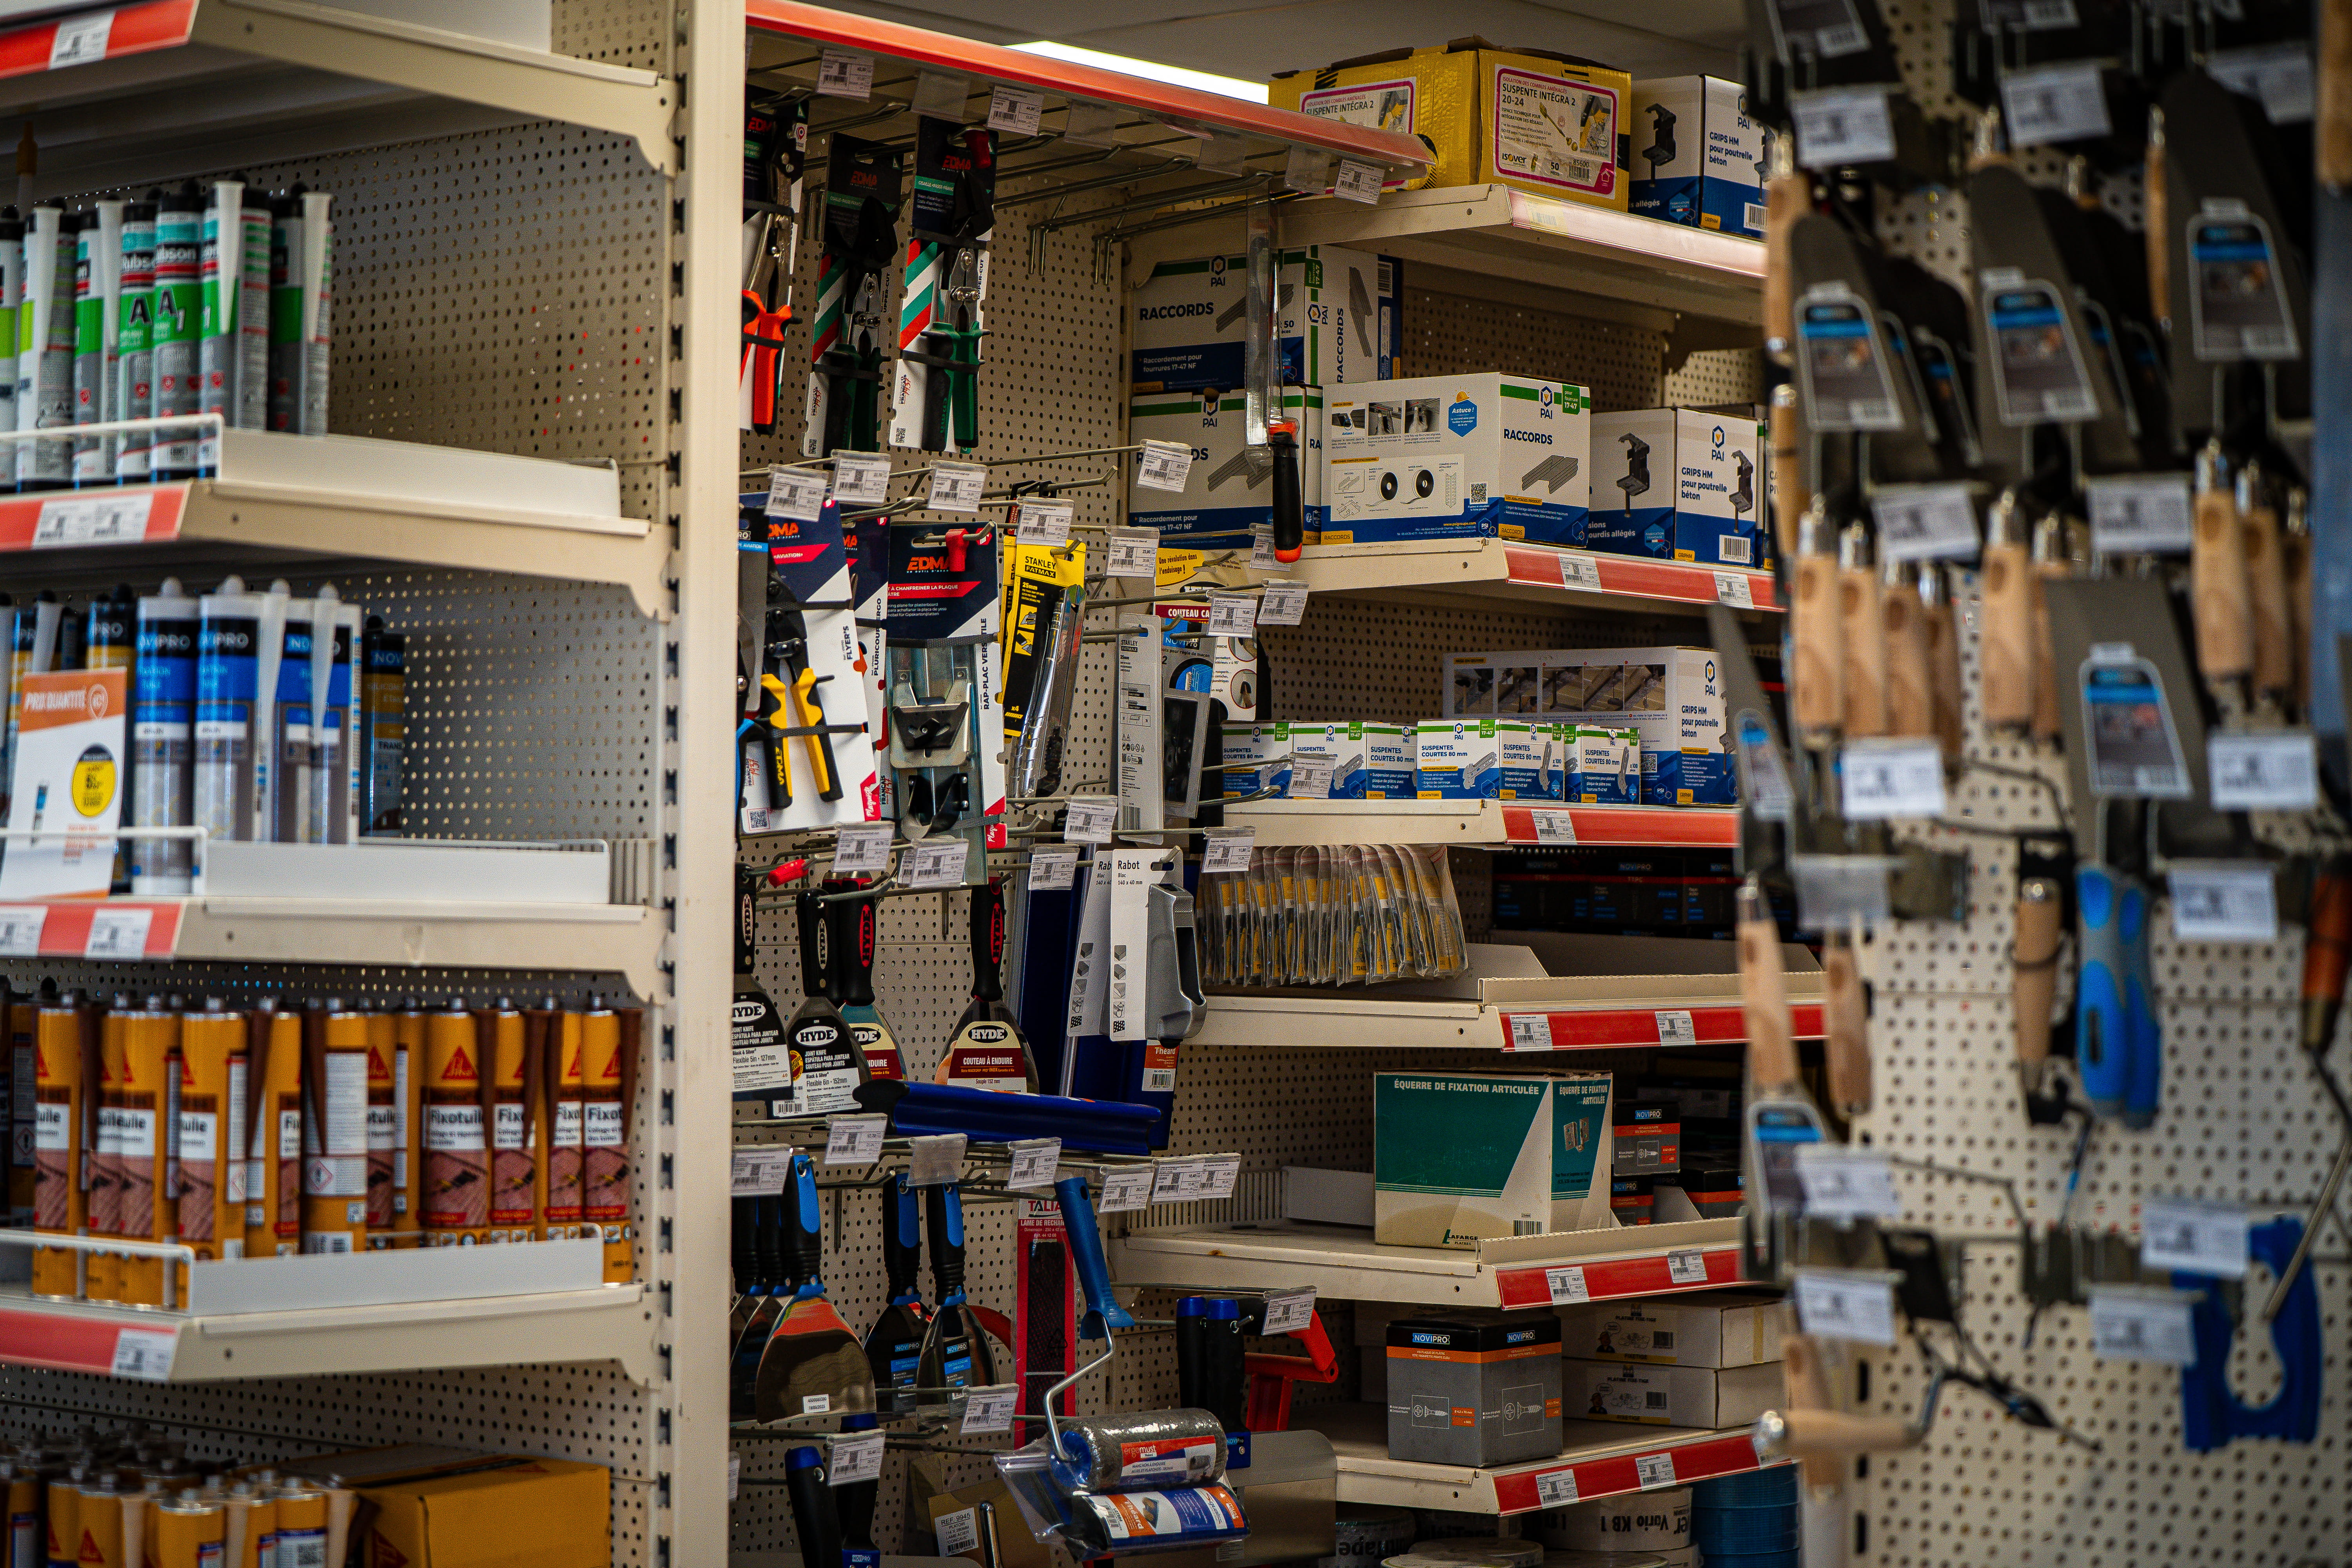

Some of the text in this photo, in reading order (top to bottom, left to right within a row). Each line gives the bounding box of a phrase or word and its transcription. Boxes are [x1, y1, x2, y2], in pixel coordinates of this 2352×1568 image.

[1503, 83, 1575, 106] SUSPENTE INTÉGRA 2
[1502, 94, 1524, 107] 20-24
[1306, 105, 1338, 115] SUSPENTE
[1339, 101, 1368, 112] INTÉGRA
[1737, 117, 1750, 129] PAI
[1709, 132, 1739, 146] GRIPS HM
[1709, 144, 1753, 161] pour poutrelle
[942, 155, 971, 170] EDMA
[1709, 154, 1727, 166] béton
[1550, 162, 1559, 171] 50
[851, 171, 877, 185] EDMA
[1635, 199, 1660, 208] allégés
[1210, 277, 1225, 287] PAI
[1140, 302, 1214, 320] RACCORDS
[1143, 354, 1202, 363] Raccordement pour
[1143, 364, 1170, 373] fourrures
[1540, 408, 1553, 419] PAI
[1203, 418, 1218, 428] PAI
[1503, 428, 1553, 445] RACCORDS
[1711, 450, 1724, 462] PAI
[1682, 467, 1713, 479] GRIPS HM
[1682, 480, 1727, 492] pour poutrelle
[1681, 490, 1700, 501] béton
[1025, 556, 1056, 570] STANLEY
[1167, 554, 1187, 563] révolution
[1026, 566, 1055, 577] FATMAX
[1023, 582, 1038, 590] 25mm
[1168, 608, 1199, 617] COUTEAU
[1705, 685, 1716, 696] PAI
[1682, 705, 1707, 715] GRIPS HM
[1682, 718, 1719, 728] pour poutrelle
[1682, 728, 1697, 737] béton
[1098, 861, 1111, 870] Rab
[1117, 860, 1140, 870] Rabot
[799, 1030, 835, 1043] HYDE
[971, 1029, 1004, 1040] HYDE
[732, 1056, 749, 1064] Flexible
[963, 1057, 985, 1065] COUTEAU
[986, 1055, 991, 1064] À
[806, 1080, 822, 1088] Flexible
[1394, 1078, 1539, 1095] ÉQUERRE DE FIXATION ARTICULÉE
[430, 1108, 483, 1124] Fixotull
[1636, 1110, 1661, 1119] NOVIPRO
[1442, 1229, 1478, 1244] LAFARGE
[1413, 1333, 1450, 1344] NOVIPRO
[895, 1341, 921, 1352] NOVIPRO
[1124, 1445, 1156, 1457] ergomust
[940, 1512, 971, 1526] REF. 9945
